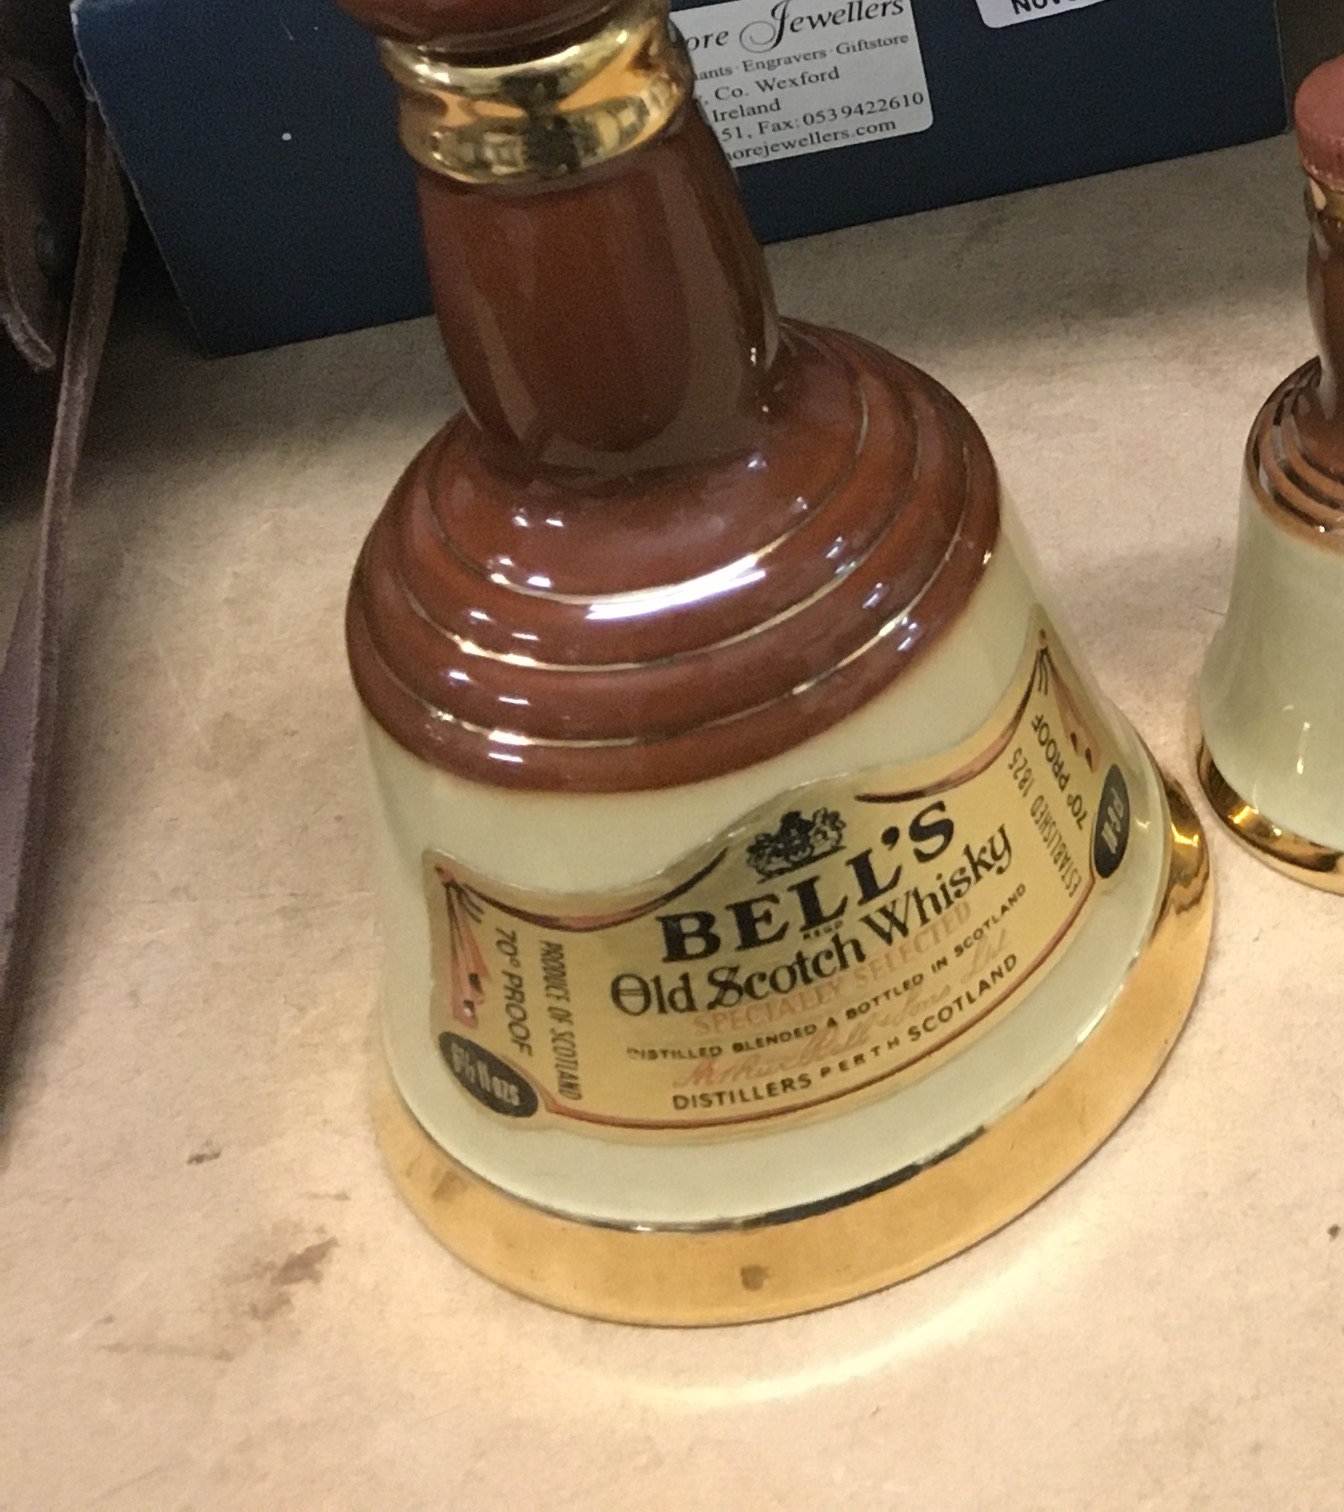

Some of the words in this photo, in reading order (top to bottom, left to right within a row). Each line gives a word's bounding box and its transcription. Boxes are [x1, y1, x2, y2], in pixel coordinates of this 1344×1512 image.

[742, 48, 827, 74] Engravers
[836, 33, 909, 56] Giftstore
[755, 66, 840, 93] Wexford
[712, 98, 781, 123] Ireland
[1007, 746, 1036, 798] 1825
[1030, 714, 1071, 793] PROOF
[655, 800, 955, 964] BELL'S
[1029, 794, 1083, 898] ESTABLISHED
[610, 971, 698, 1017] Old
[705, 932, 867, 1011] Scotch
[858, 823, 1014, 948] Whisky
[854, 899, 972, 989] SELECTED
[501, 969, 534, 1058] PROOF
[626, 1043, 723, 1062] DISTILLED
[732, 1022, 818, 1055] BLENDED
[845, 971, 925, 1021] BOTTLED
[930, 955, 949, 974] IN
[953, 881, 1028, 959] SCOTLAND
[547, 1005, 574, 1026] OF
[671, 1071, 812, 1112] DISTILLERS
[820, 1034, 901, 1080] PERTH
[906, 953, 1019, 1044] SCOTLAND
[551, 1027, 583, 1101] SCOTLAND
